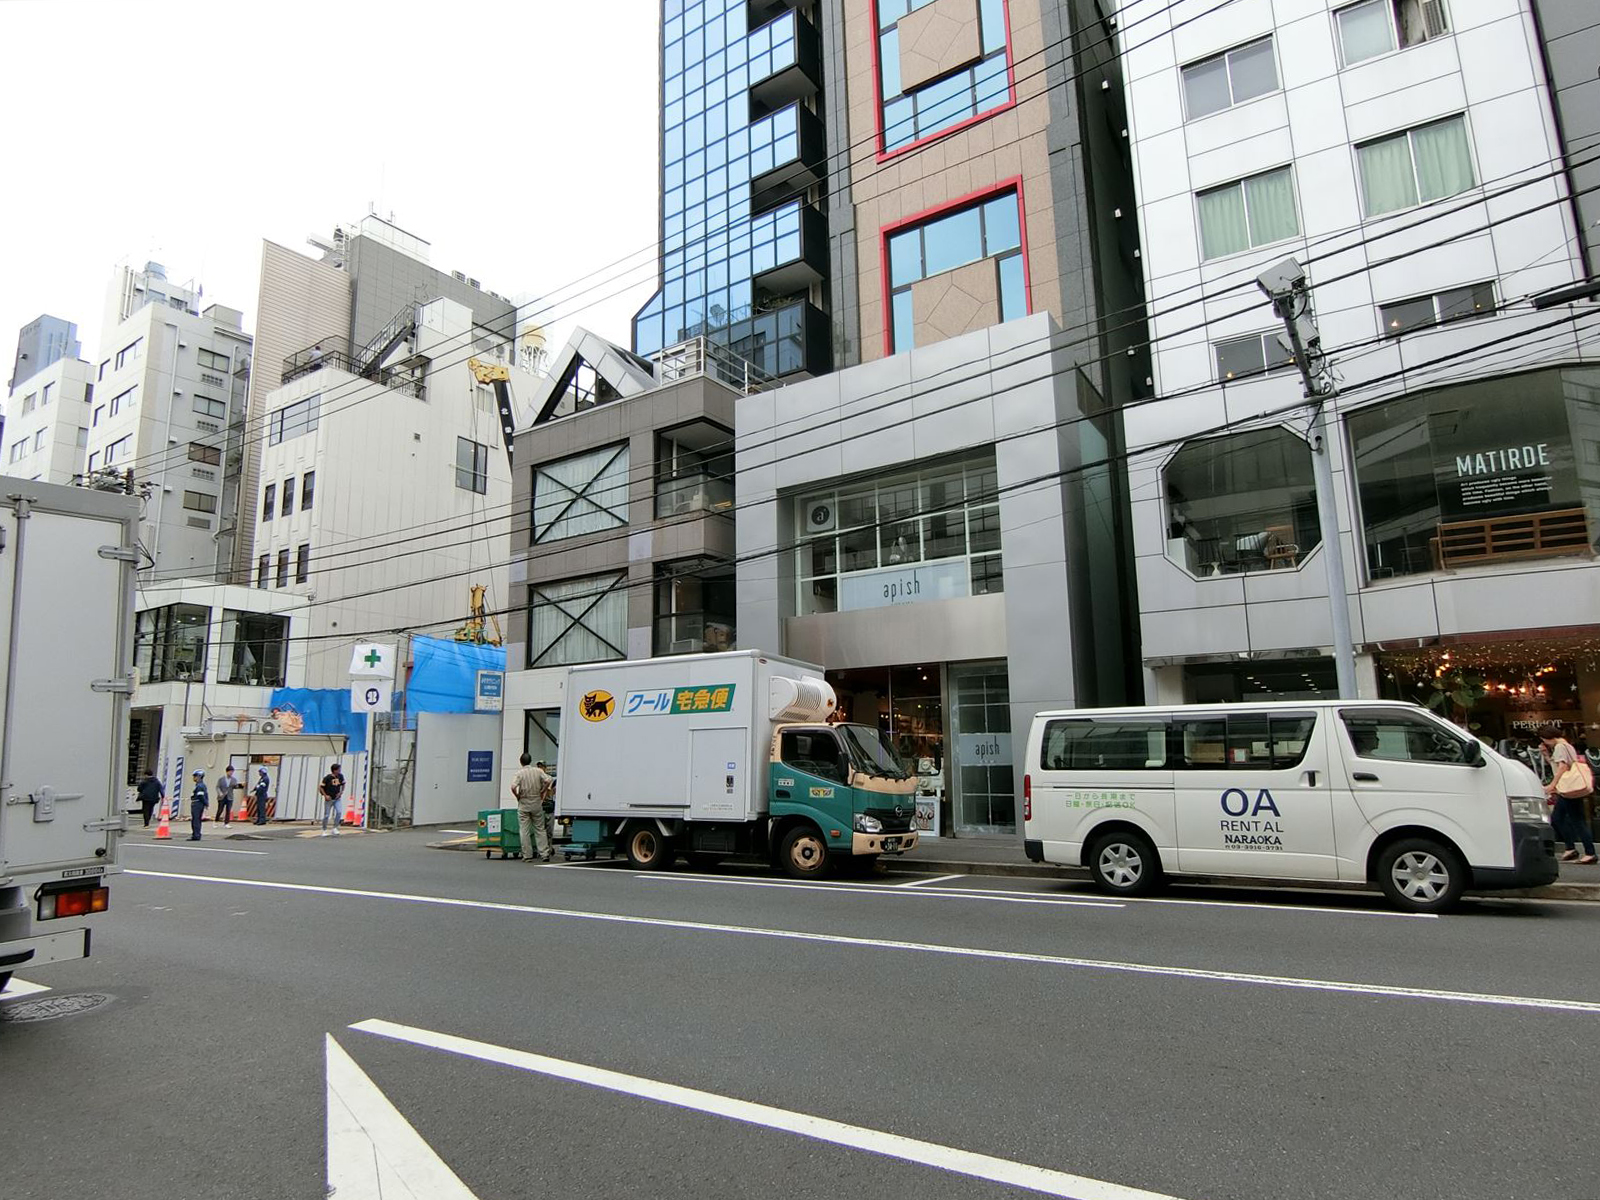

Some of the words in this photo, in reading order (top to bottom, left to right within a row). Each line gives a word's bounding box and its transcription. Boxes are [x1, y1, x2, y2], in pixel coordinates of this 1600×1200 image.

[1456, 443, 1551, 477] MATIRDE
[883, 569, 920, 602] apish
[627, 692, 670, 714] クール
[676, 687, 730, 711] 宅急便
[975, 735, 1000, 759] apish
[1220, 787, 1282, 817] OA
[1220, 820, 1285, 833] RENTAL
[1224, 834, 1283, 845] NARAOKA
